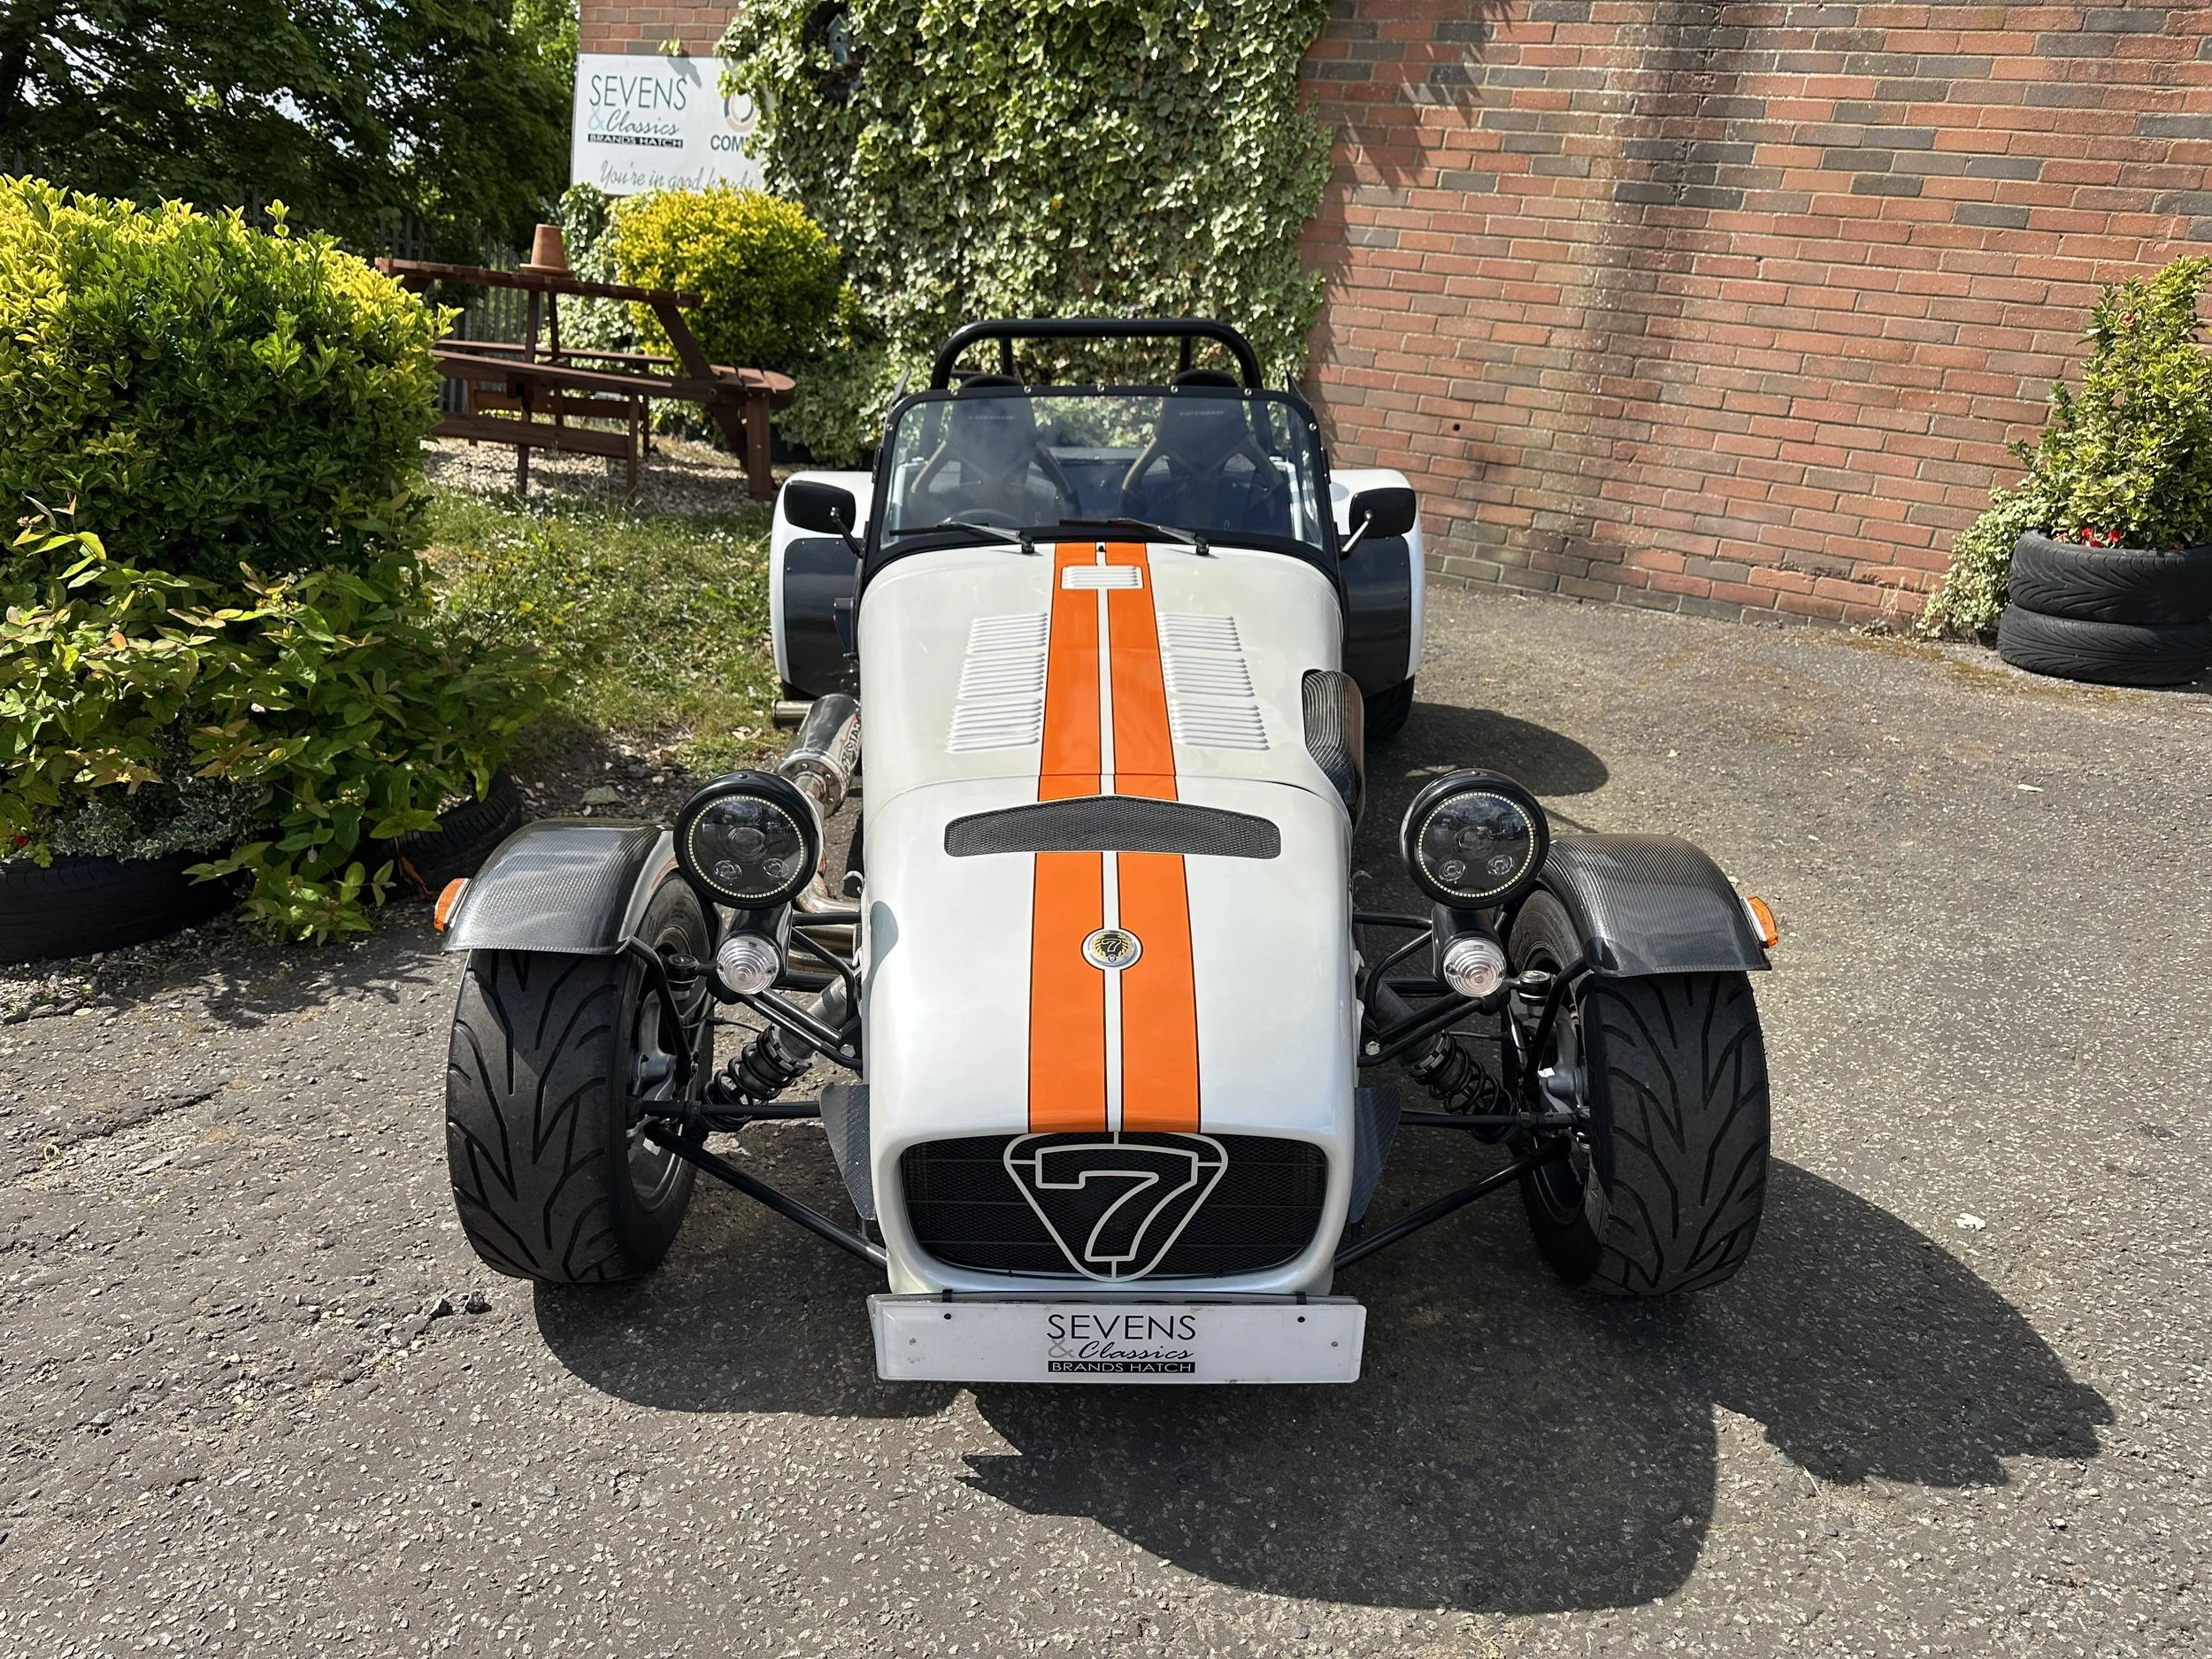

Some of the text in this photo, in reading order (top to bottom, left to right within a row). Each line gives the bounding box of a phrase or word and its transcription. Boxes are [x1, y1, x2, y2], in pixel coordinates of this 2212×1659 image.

[589, 74, 687, 111] SEVENS
[606, 108, 680, 136] Classics
[590, 134, 682, 148] BRANDS HATCH
[710, 134, 749, 152] COM
[600, 159, 646, 189] You're
[649, 169, 665, 188] in
[668, 166, 704, 192] good
[1101, 938, 1122, 953] 7
[1035, 1143, 1199, 1262] 7
[1047, 1314, 1196, 1340] SEVENS
[1048, 1337, 1194, 1360] & Classics
[1052, 1362, 1192, 1372] BRANDS HATCH
